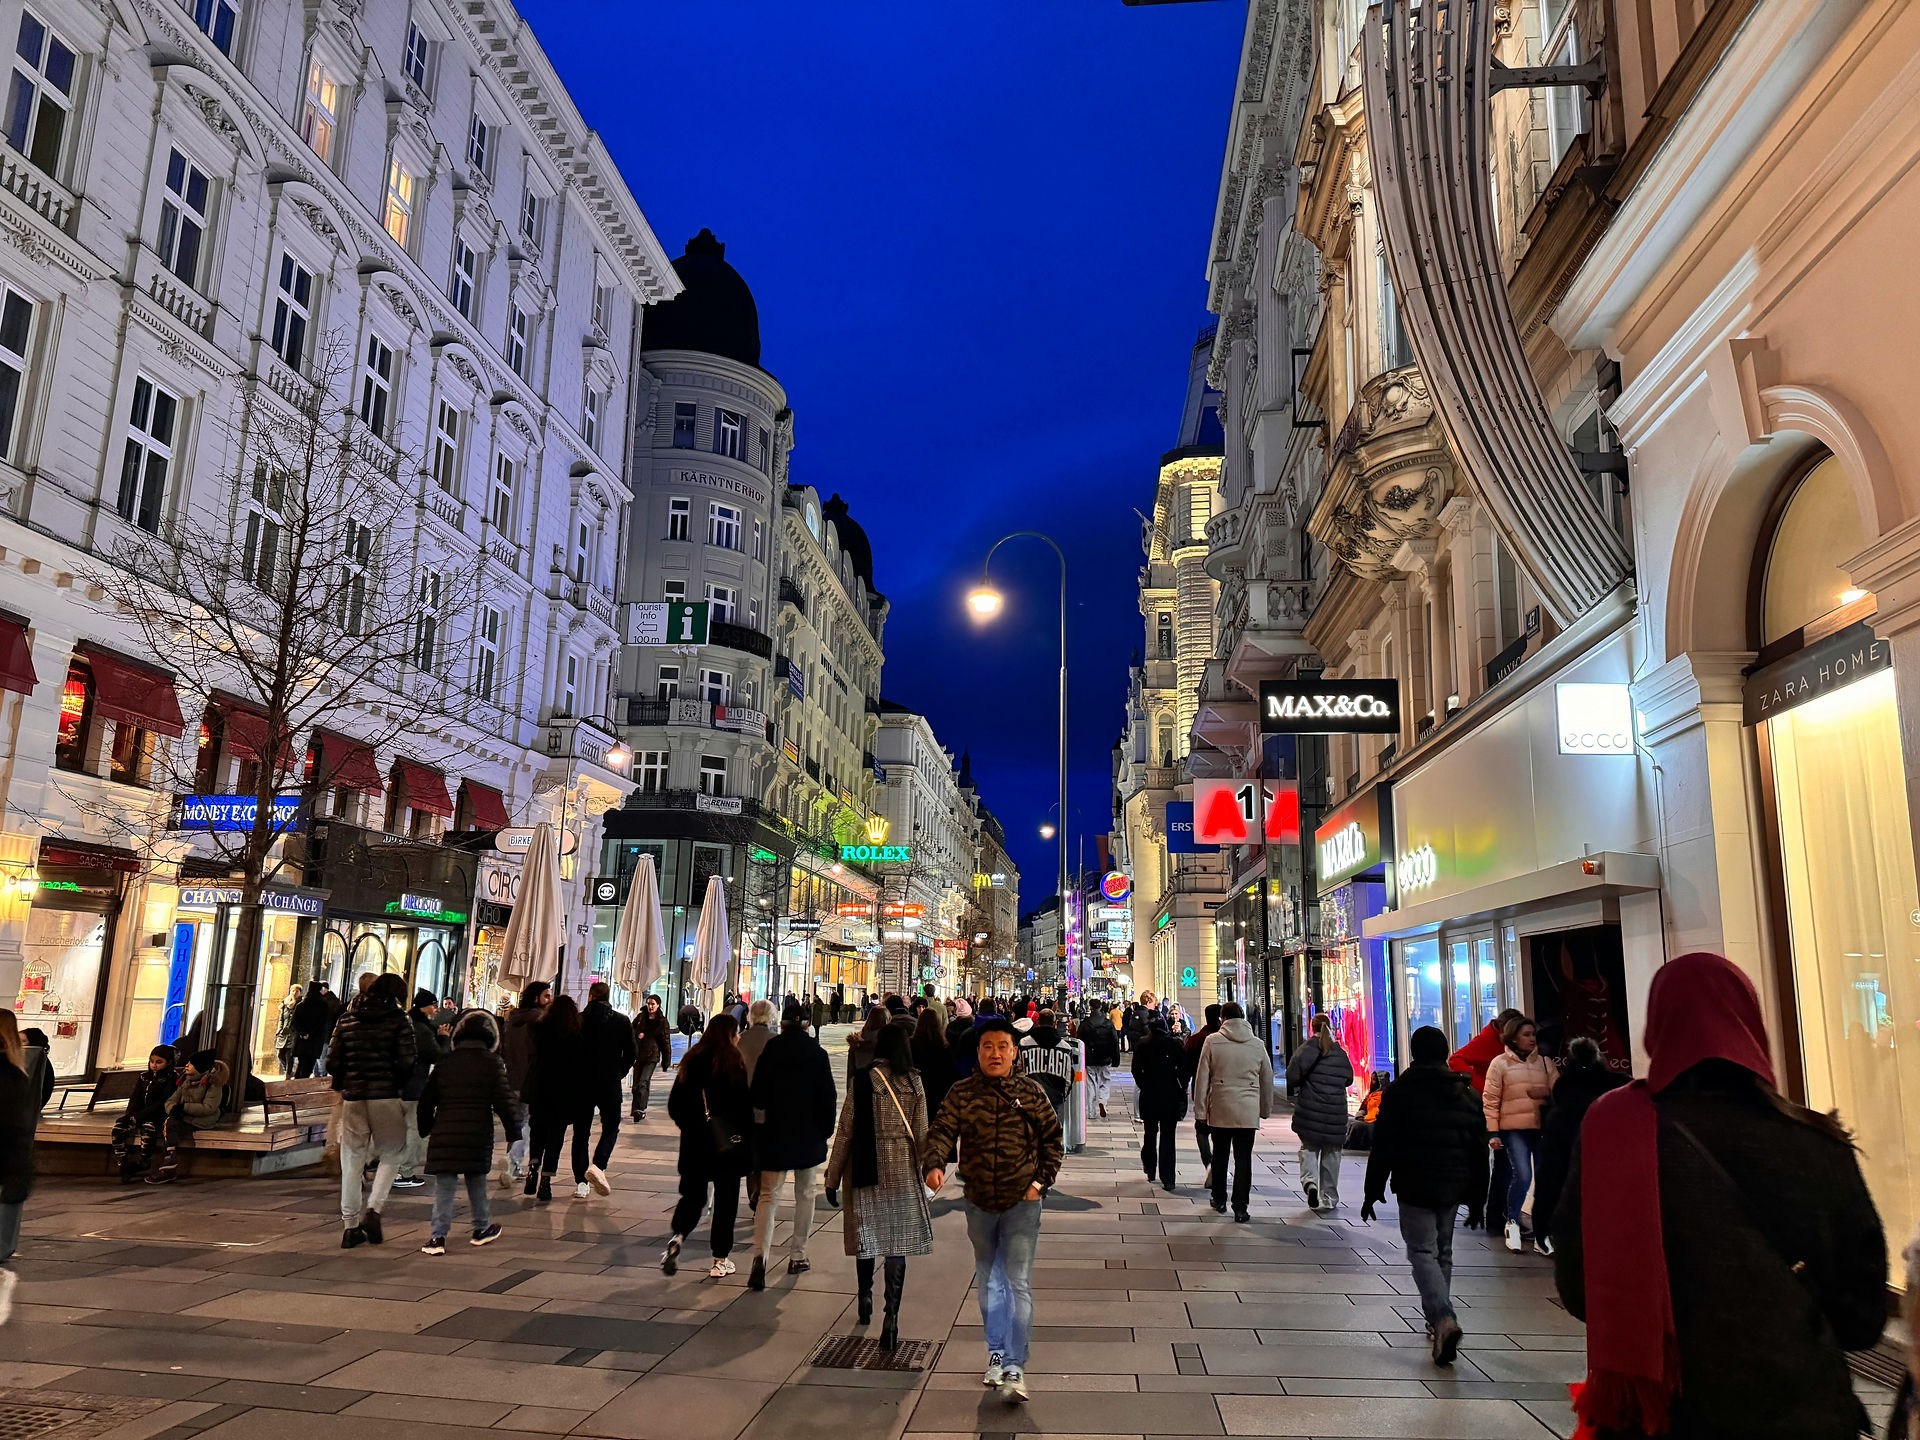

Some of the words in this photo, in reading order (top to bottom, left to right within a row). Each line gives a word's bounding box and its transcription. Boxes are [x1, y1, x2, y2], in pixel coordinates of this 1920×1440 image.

[680, 471, 765, 504] KÄRNTNERHOF
[634, 603, 664, 611] Tourist-
[640, 611, 657, 620] Info
[634, 635, 650, 643] 100
[1759, 675, 1809, 711] ZARA
[1819, 641, 1881, 684] HOME
[1267, 694, 1391, 717] MAX&Co.
[125, 713, 158, 731] SACHER
[1564, 733, 1628, 749] ecco
[710, 799, 740, 809] RENNER
[1201, 784, 1255, 838] A1
[183, 804, 230, 821] MONEY
[842, 845, 910, 860] ROLEX
[79, 855, 114, 870] SACHER
[1021, 1047, 1072, 1082] CHICAGO
